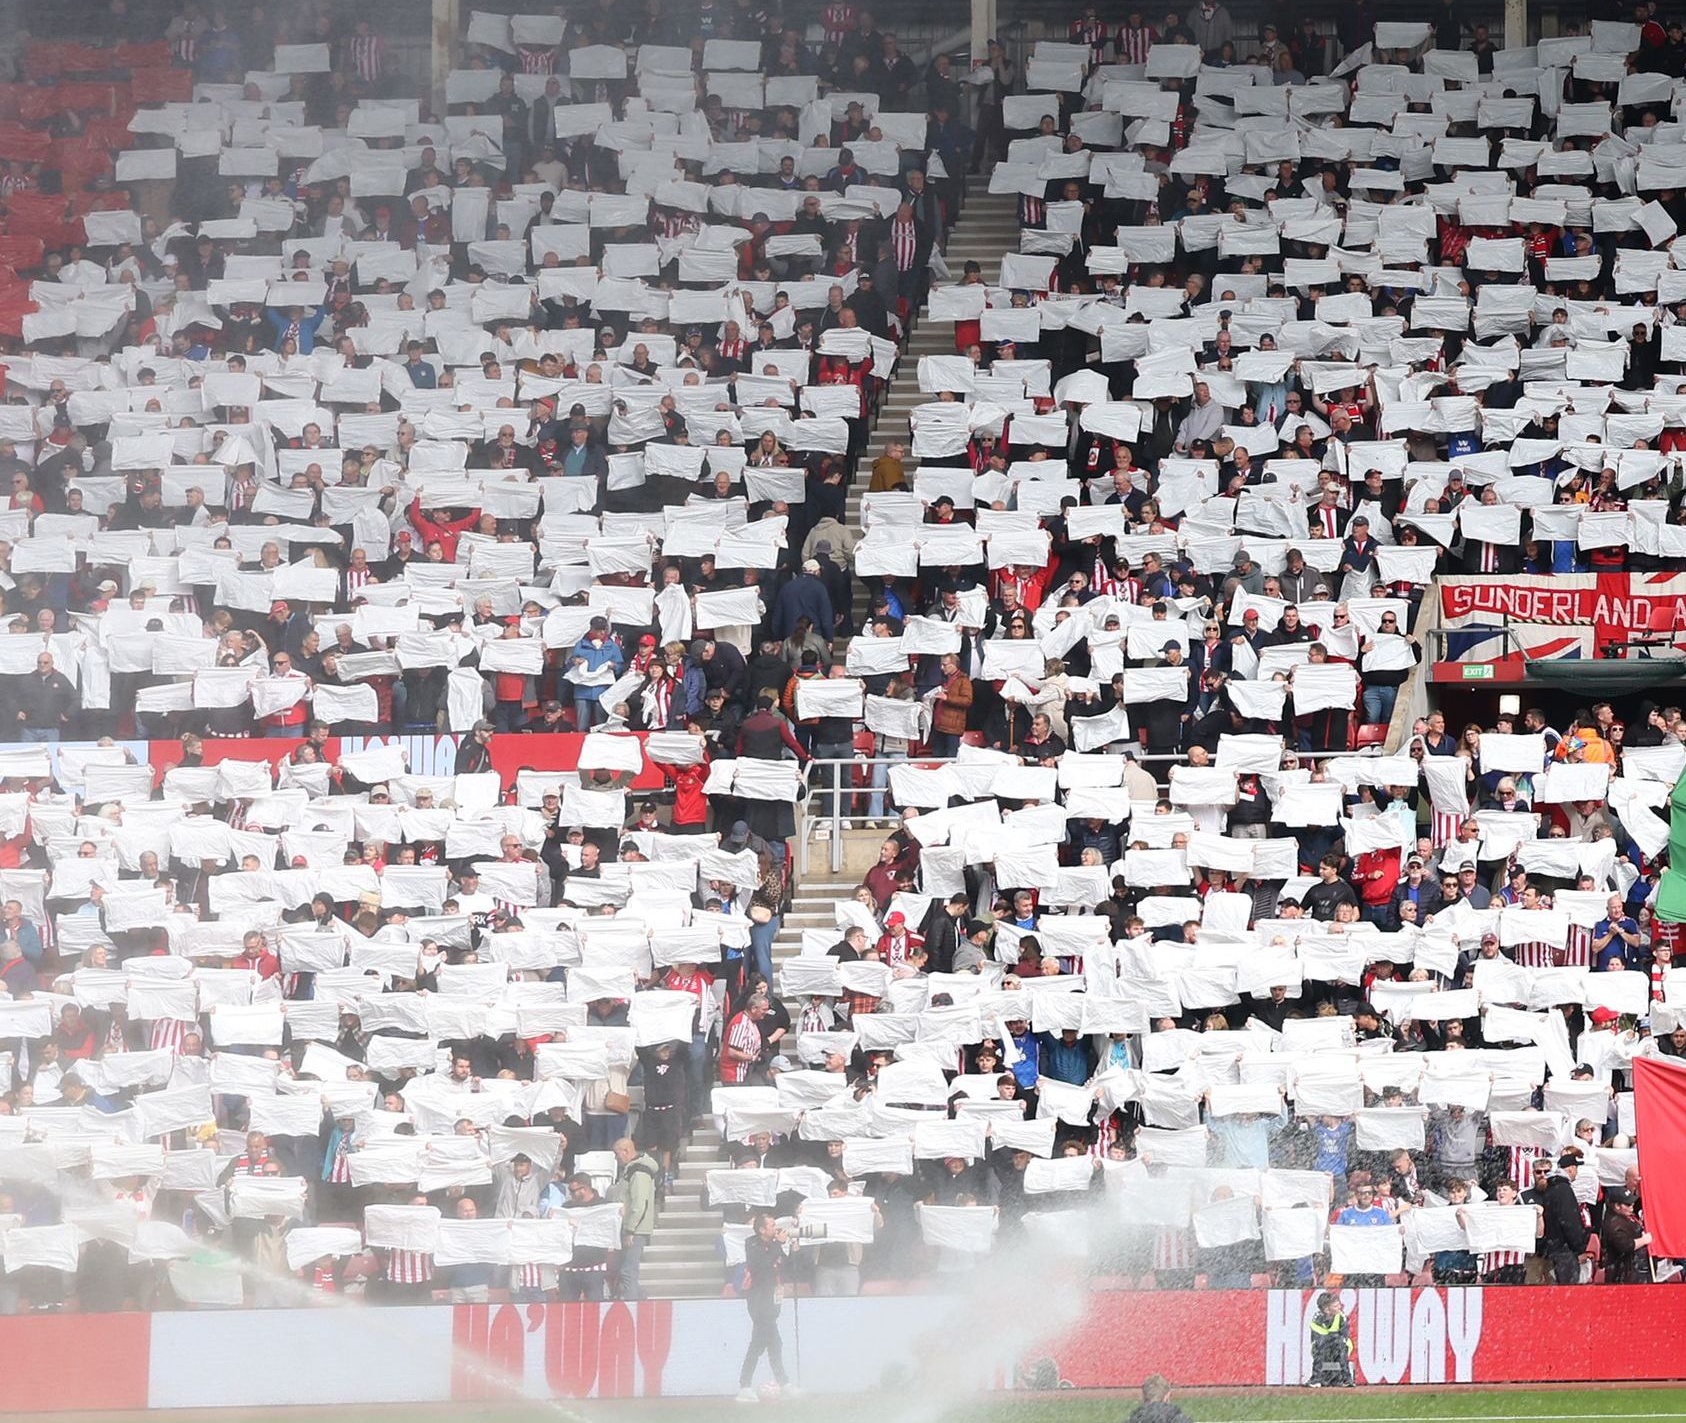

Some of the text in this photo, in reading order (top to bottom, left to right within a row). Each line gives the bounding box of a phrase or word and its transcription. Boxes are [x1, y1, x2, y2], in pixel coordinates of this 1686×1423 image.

[1453, 585, 1652, 629] SUNDERLAND
[1464, 667, 1483, 676] EXIT
[451, 1302, 672, 1401] HA'WAY
